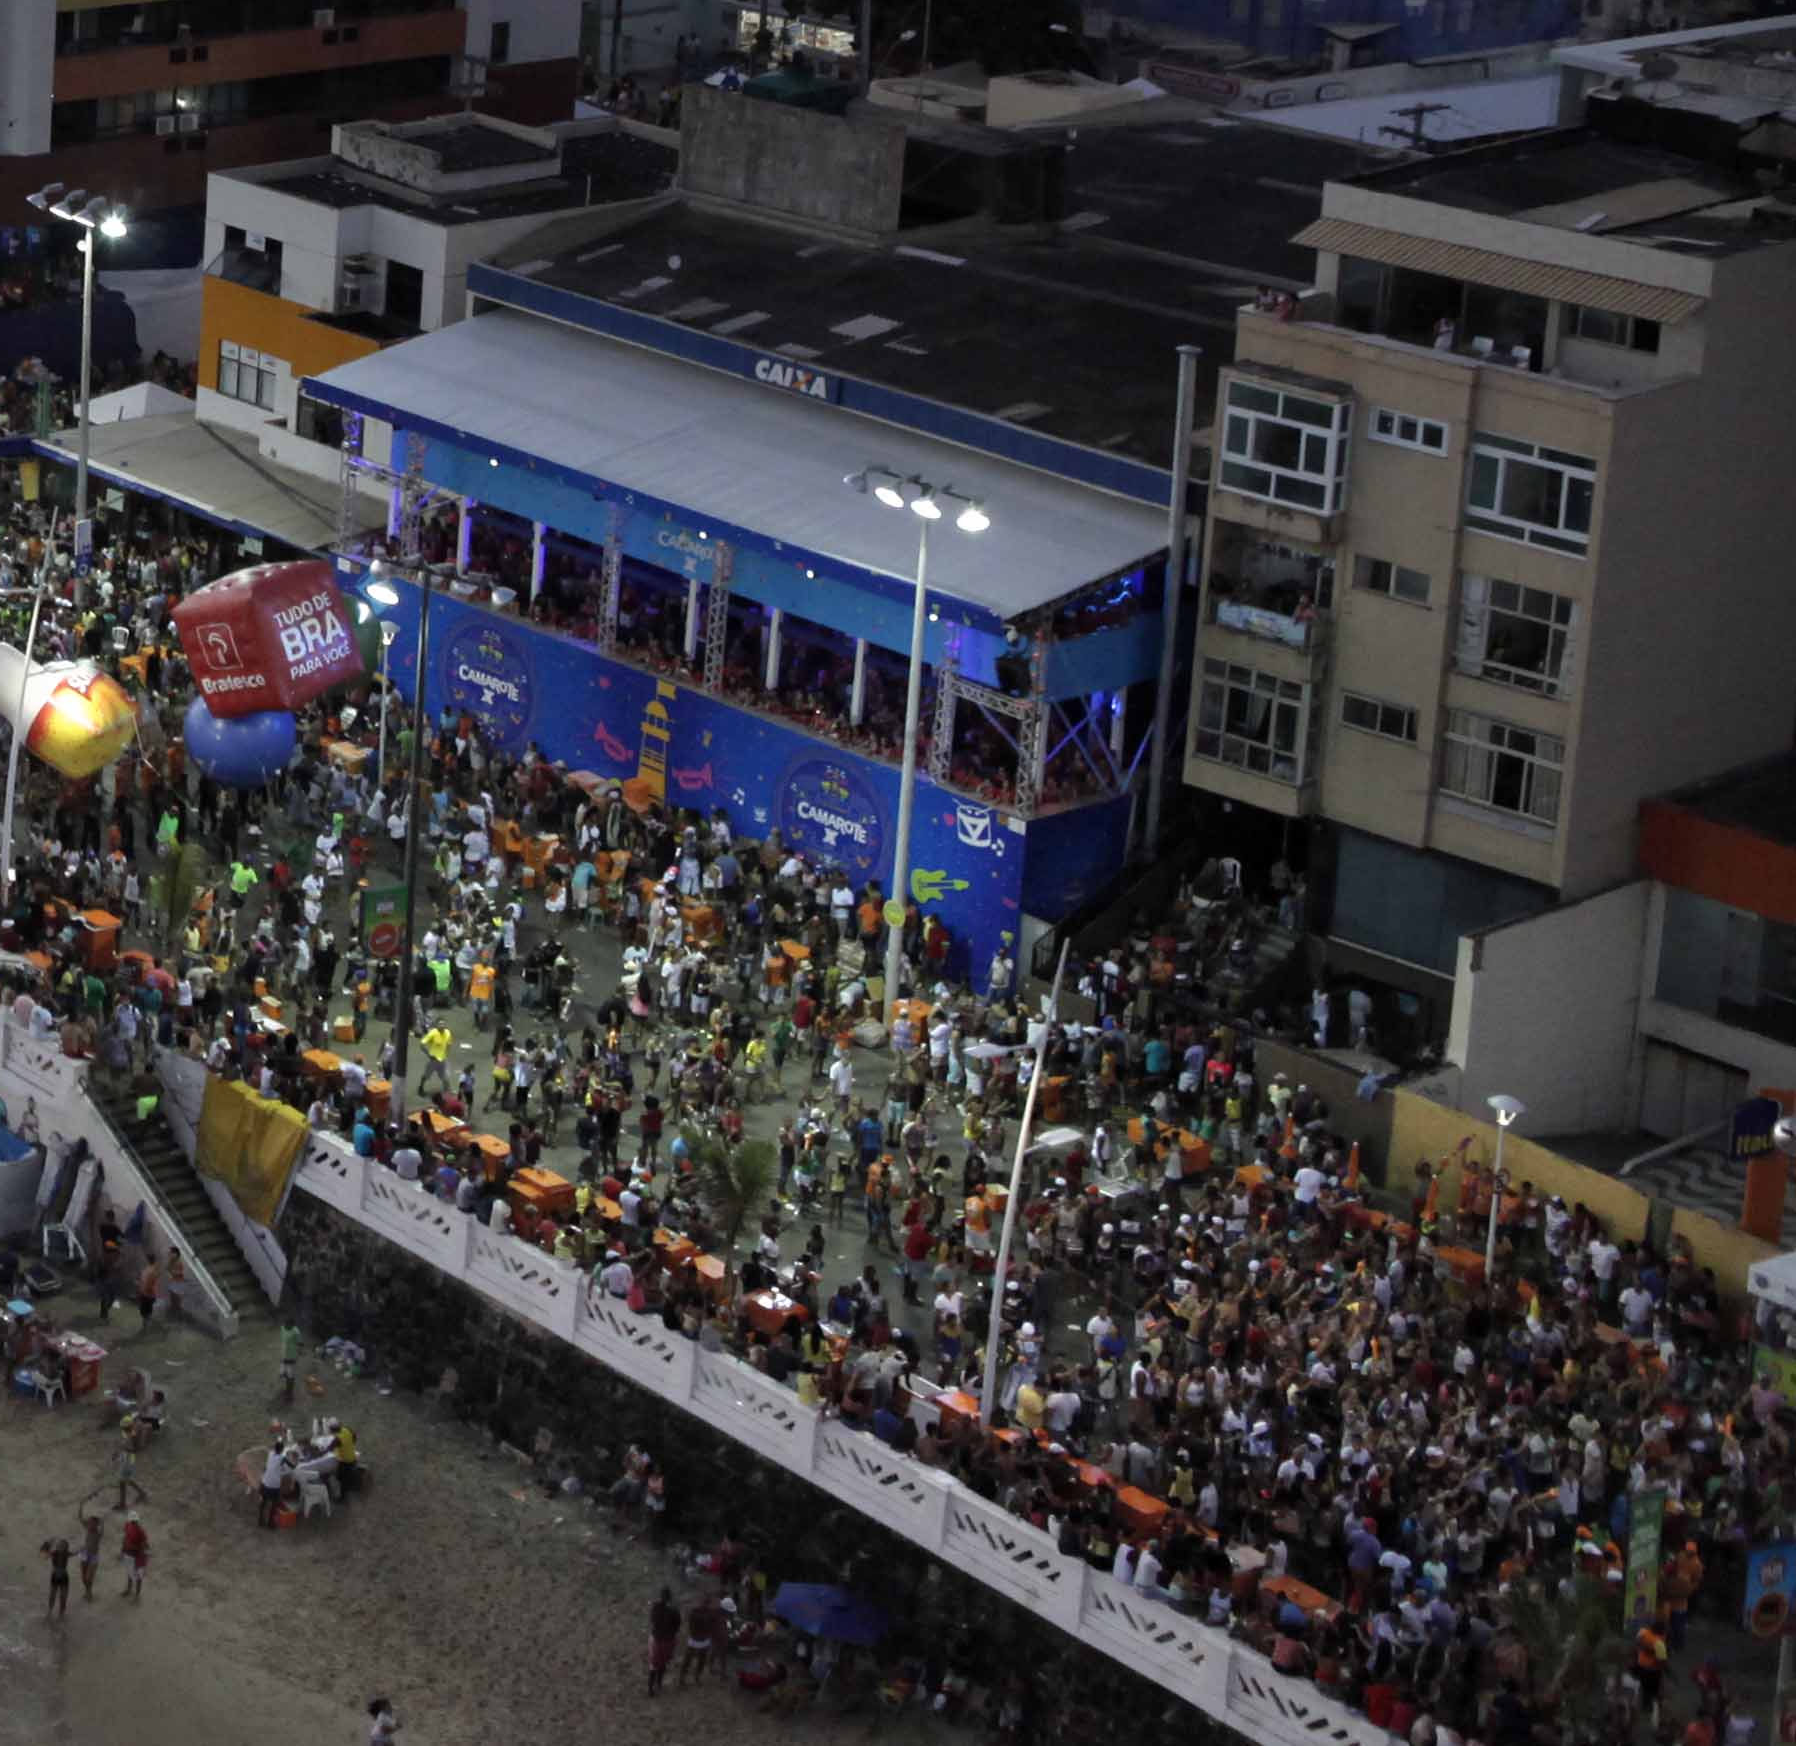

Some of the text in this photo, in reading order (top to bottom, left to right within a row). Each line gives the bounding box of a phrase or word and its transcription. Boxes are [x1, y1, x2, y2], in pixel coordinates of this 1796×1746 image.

[755, 359, 826, 398] CAIXA
[273, 591, 333, 628] TUDO DE
[280, 610, 346, 662] BRA
[290, 640, 352, 681] PARA VOCÊ
[201, 673, 266, 695] Bradesco
[459, 664, 519, 702] CAMAROTE
[797, 801, 867, 844] CAMAROTE
